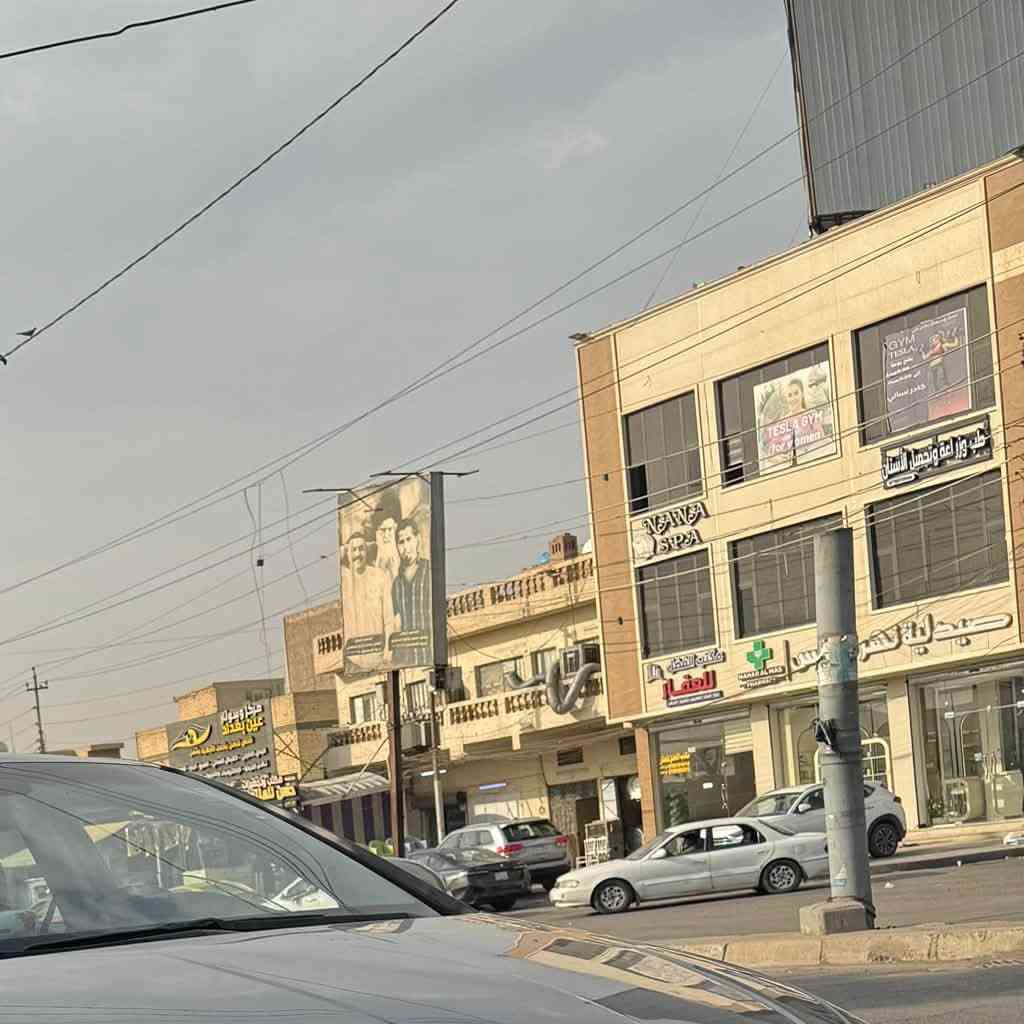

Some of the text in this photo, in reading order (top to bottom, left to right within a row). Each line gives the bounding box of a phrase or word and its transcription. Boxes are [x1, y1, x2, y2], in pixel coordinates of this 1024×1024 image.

[659, 529, 703, 552] SPA
[900, 612, 1013, 656] صيدلية
[222, 717, 264, 736] عين بغداد
